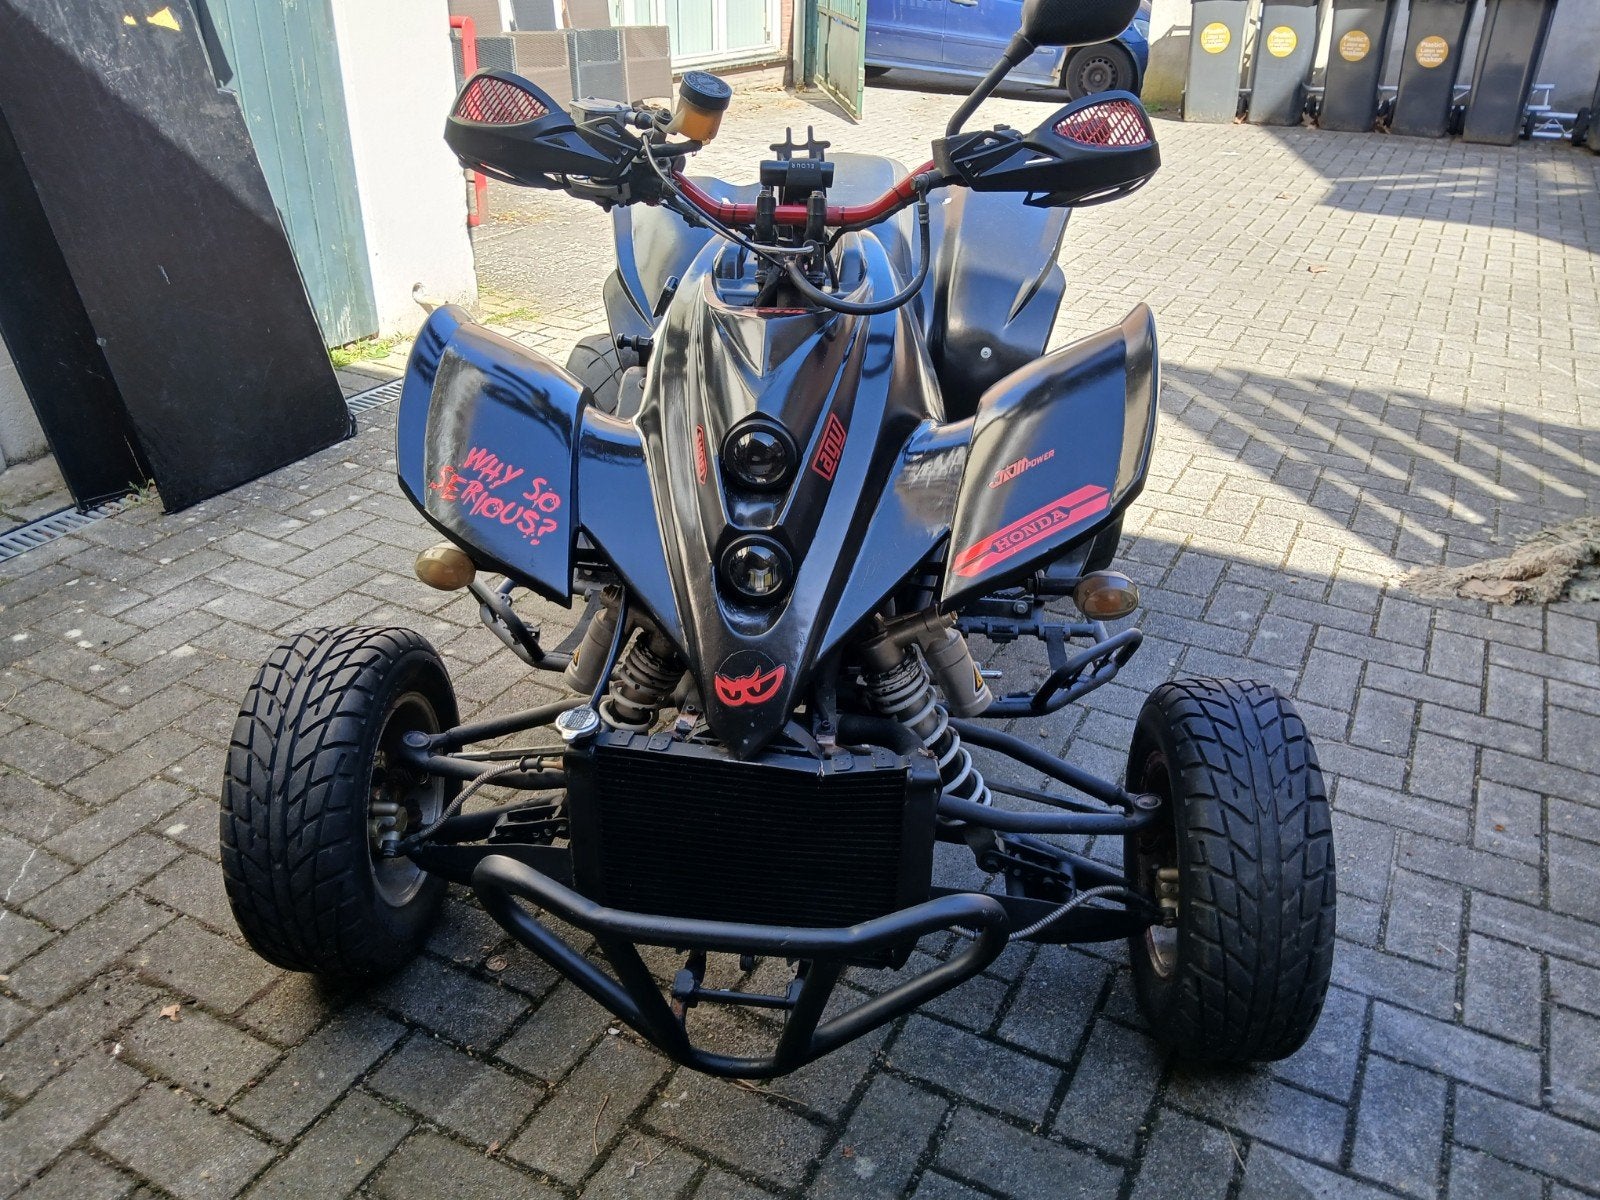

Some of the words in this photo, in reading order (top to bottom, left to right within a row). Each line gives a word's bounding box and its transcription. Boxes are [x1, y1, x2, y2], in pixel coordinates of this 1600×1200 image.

[463, 446, 524, 489] WHY
[523, 477, 561, 512] SO
[1025, 449, 1055, 470] POWER
[428, 466, 558, 545] SERIOUS?
[993, 510, 1068, 552] HONDA
